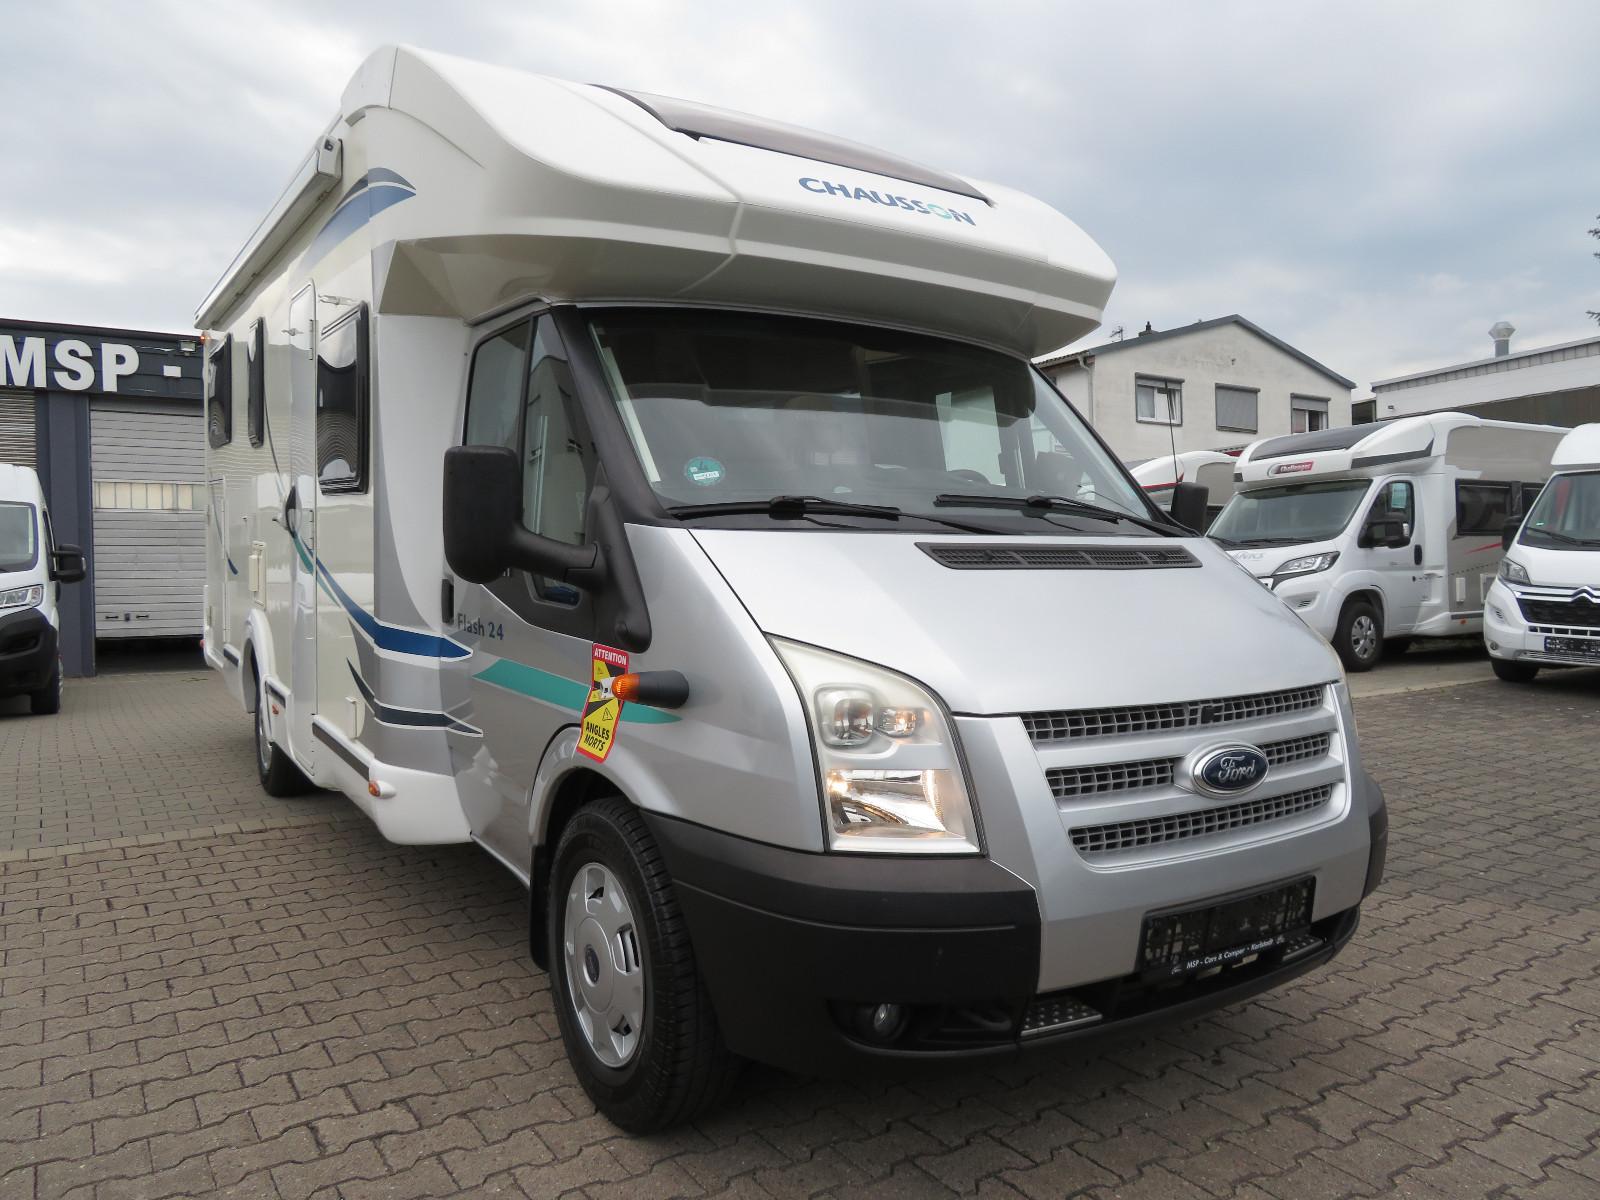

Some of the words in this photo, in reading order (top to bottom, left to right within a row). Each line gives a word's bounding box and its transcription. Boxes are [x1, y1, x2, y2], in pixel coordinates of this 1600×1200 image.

[798, 177, 977, 227] CHAUSSON
[0, 334, 140, 393] MSP
[458, 612, 485, 637] Flash
[488, 621, 504, 641] 24
[594, 648, 627, 665] ATTENTION
[584, 734, 606, 752] MORTS
[586, 721, 610, 741] ANGLES
[1218, 755, 1257, 783] Ford
[1186, 960, 1200, 969] MSP
[1204, 956, 1218, 965] Cars
[1225, 948, 1245, 959] Camper
